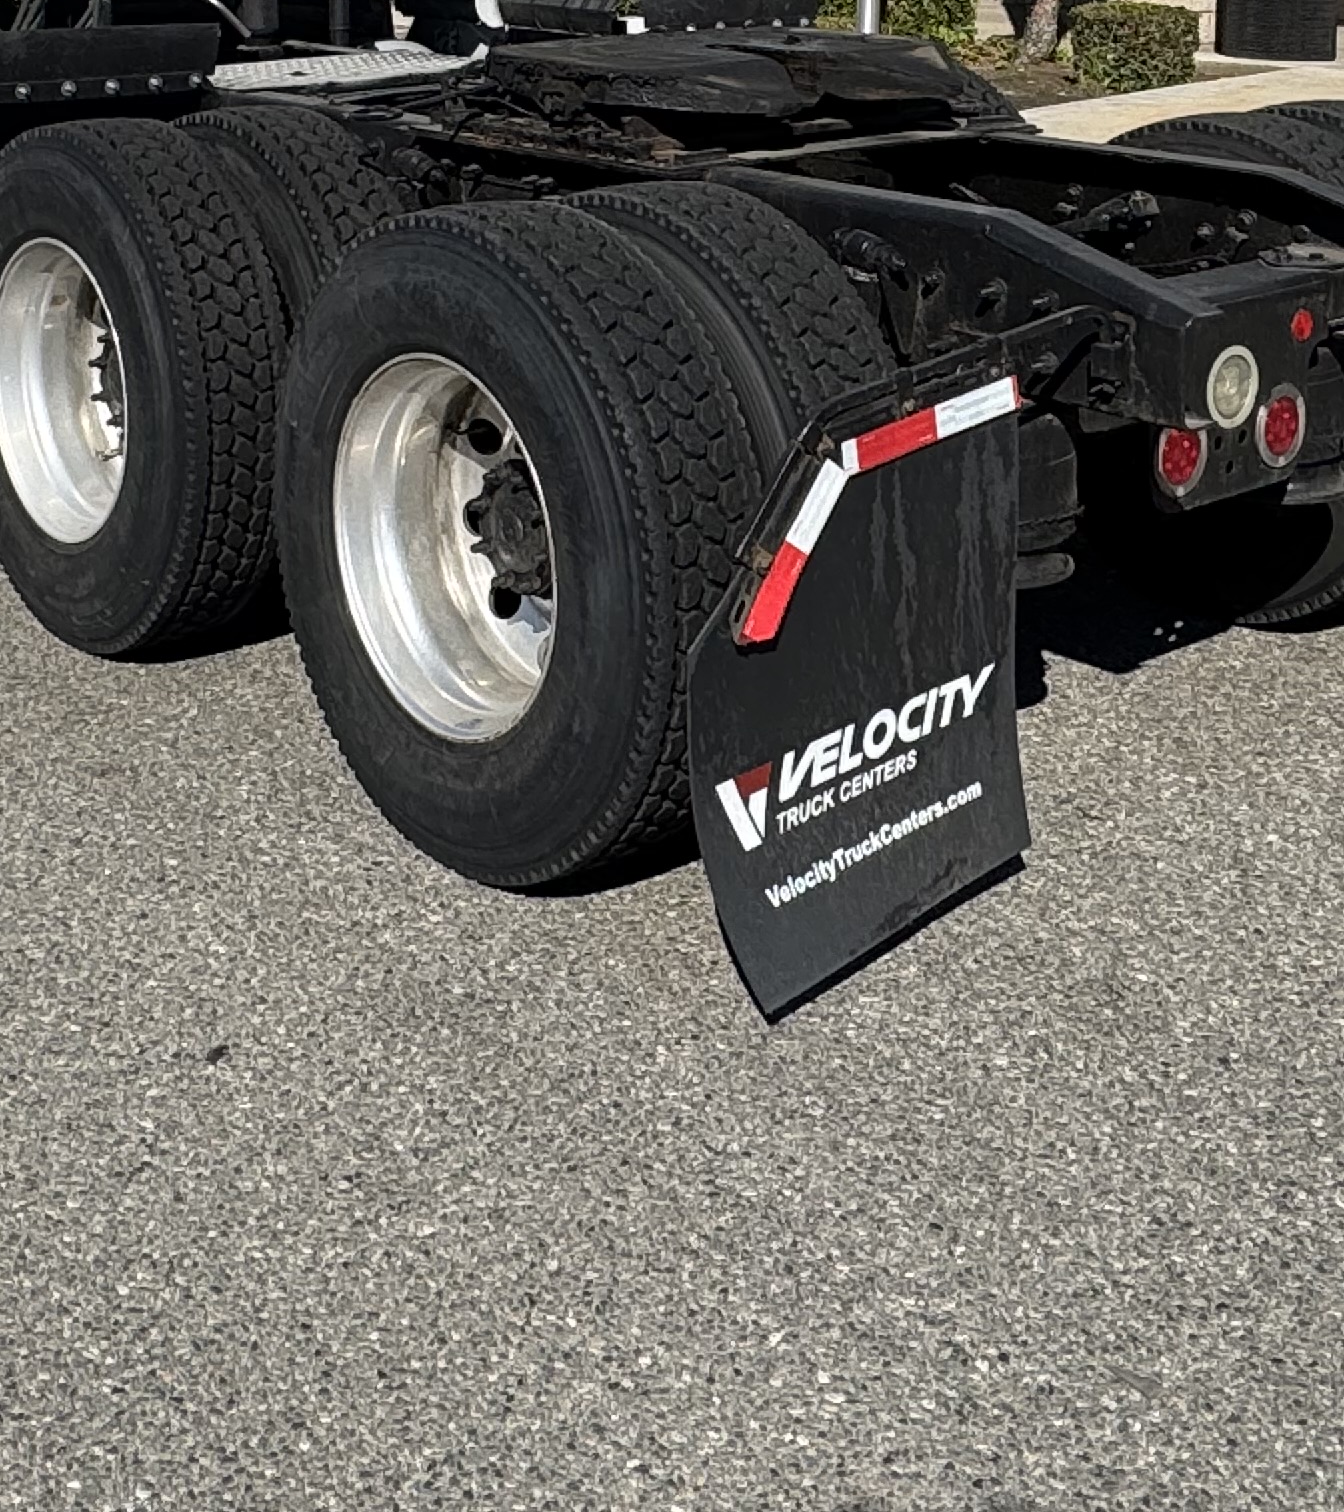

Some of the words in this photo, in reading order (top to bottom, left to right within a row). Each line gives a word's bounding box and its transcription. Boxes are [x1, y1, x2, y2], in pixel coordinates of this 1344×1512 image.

[775, 787, 835, 835] TRUCK
[839, 749, 918, 803] CENTERS
[778, 662, 996, 803] VELOCITY
[765, 781, 983, 908] VelocityTruckCenters.com
